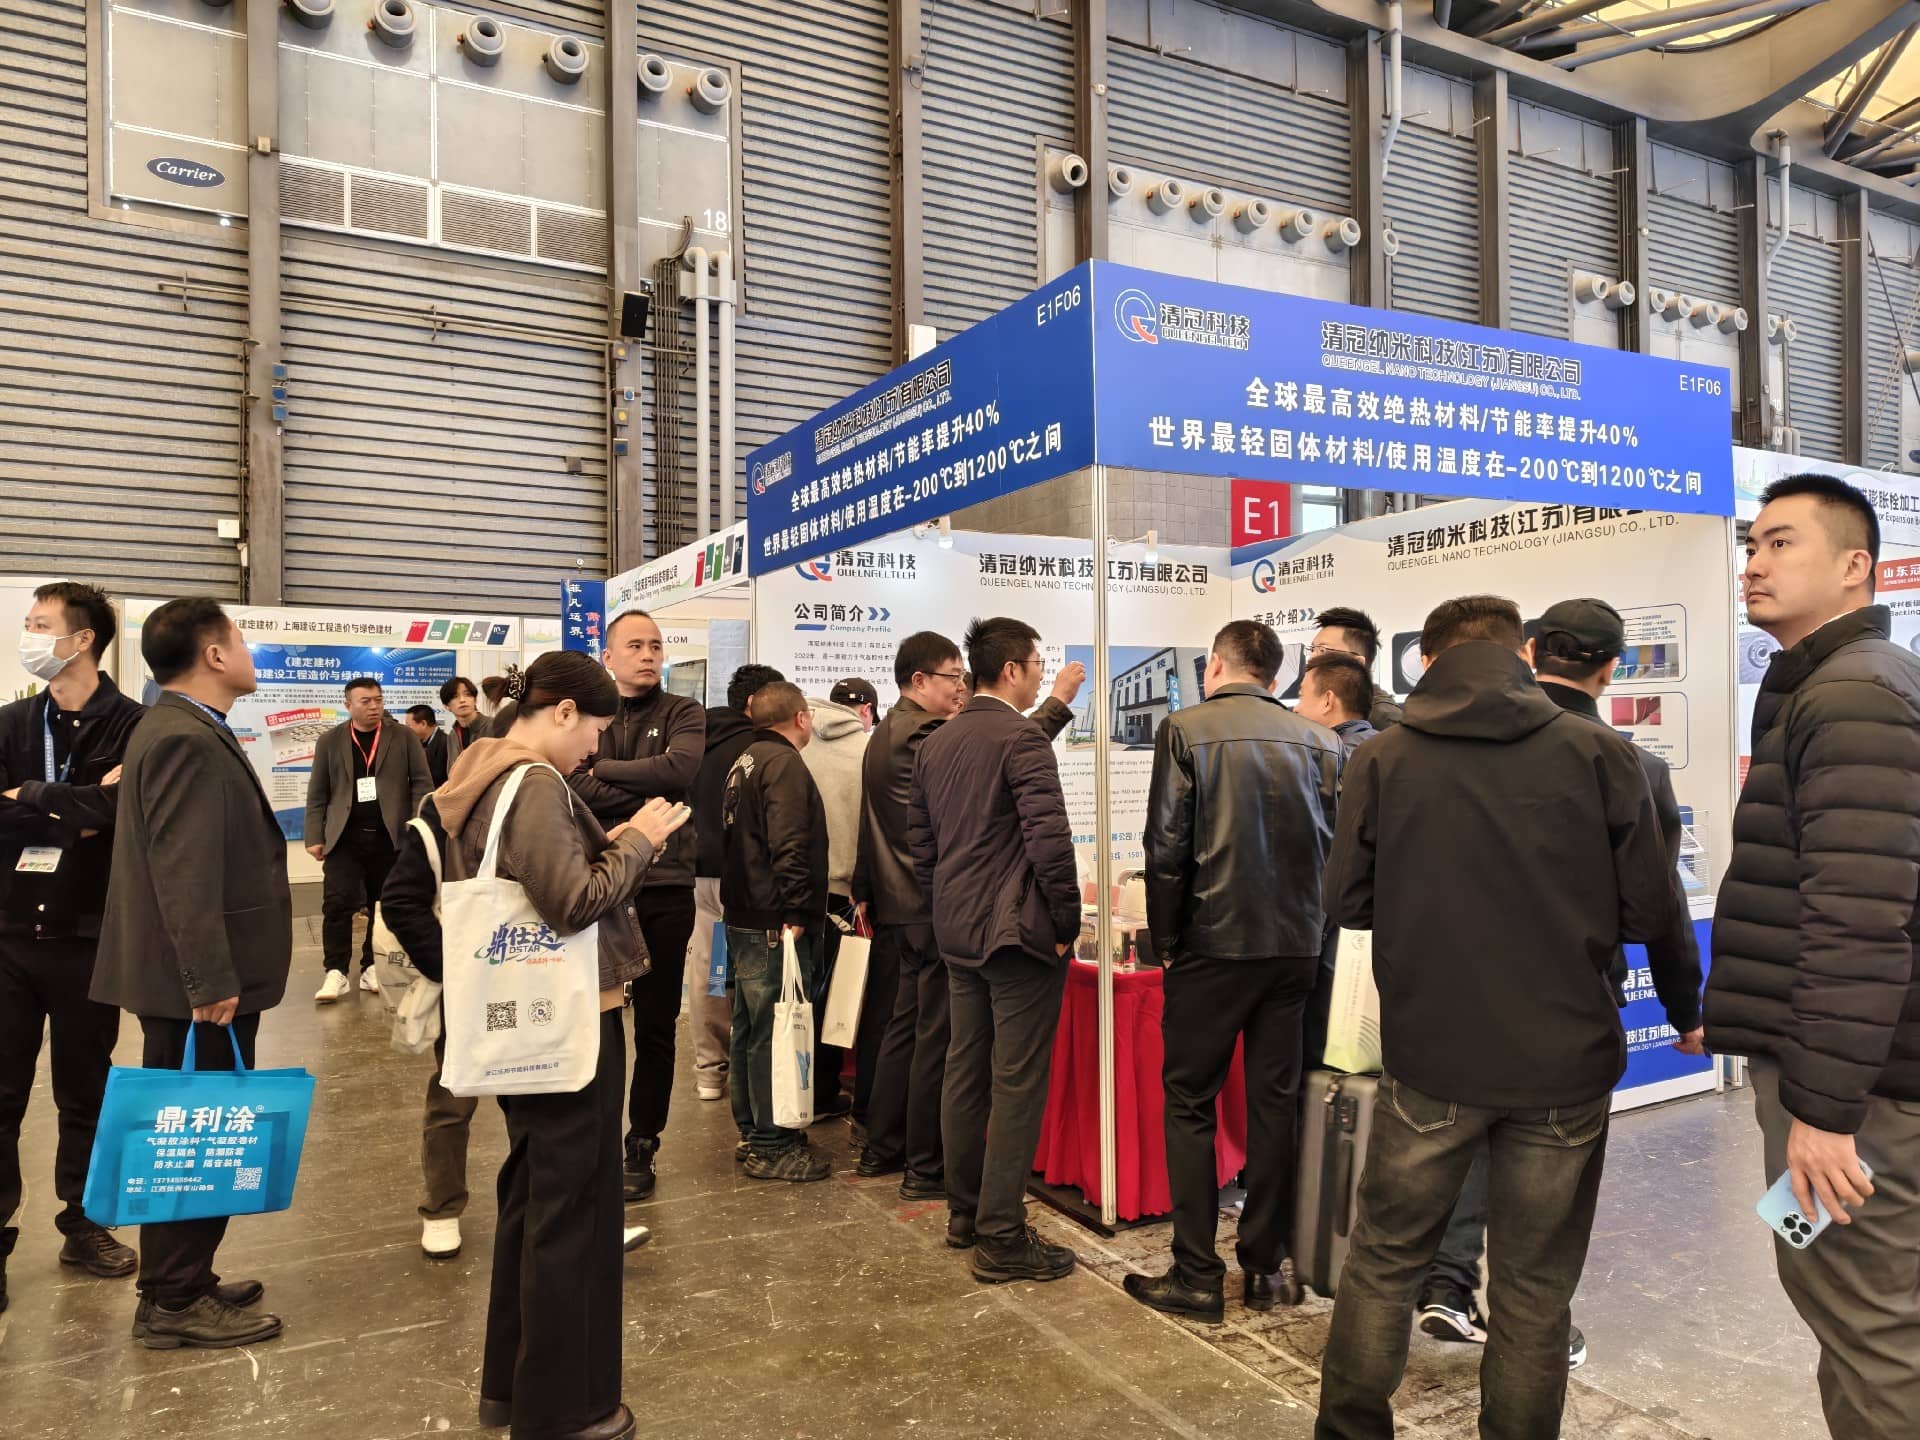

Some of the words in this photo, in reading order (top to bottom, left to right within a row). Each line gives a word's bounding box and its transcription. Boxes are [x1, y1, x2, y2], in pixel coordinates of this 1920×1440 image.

[156, 161, 216, 182] Carrier
[703, 208, 728, 231] 18
[1036, 285, 1081, 327] E1F06
[1160, 303, 1250, 338] 清冠科技
[1321, 354, 1383, 375] QUEENGEL
[1680, 374, 1721, 396] E1F06
[1246, 376, 1638, 447] 全球最高效绝热材料/节能率提升40%
[791, 400, 999, 512] 全球最高效绝热材料/节能率提升40%
[1864, 488, 1920, 513] 膨胀栓加工
[1244, 496, 1280, 536] E1
[1388, 556, 1439, 572] QUEENGEL
[1442, 549, 1471, 562] NANO
[1474, 535, 1549, 557] TECHNOLOGY
[1553, 525, 1616, 546] (JIANGSU)
[1619, 521, 1646, 534] CO.,
[1650, 514, 1679, 529] LTD.
[836, 551, 916, 570] 清冠科技
[980, 553, 1208, 584] 清冠纳米科技江苏)有限公司
[1278, 553, 1335, 577] 清冠科技
[980, 577, 1032, 589] QUEENGEL
[1034, 580, 1061, 590] NANO
[794, 603, 864, 622] 公司简介
[830, 624, 864, 634] Company
[285, 656, 341, 668] 《建定建材》
[509, 944, 540, 953] DSTAR
[154, 1106, 256, 1133] 鼎利涂
